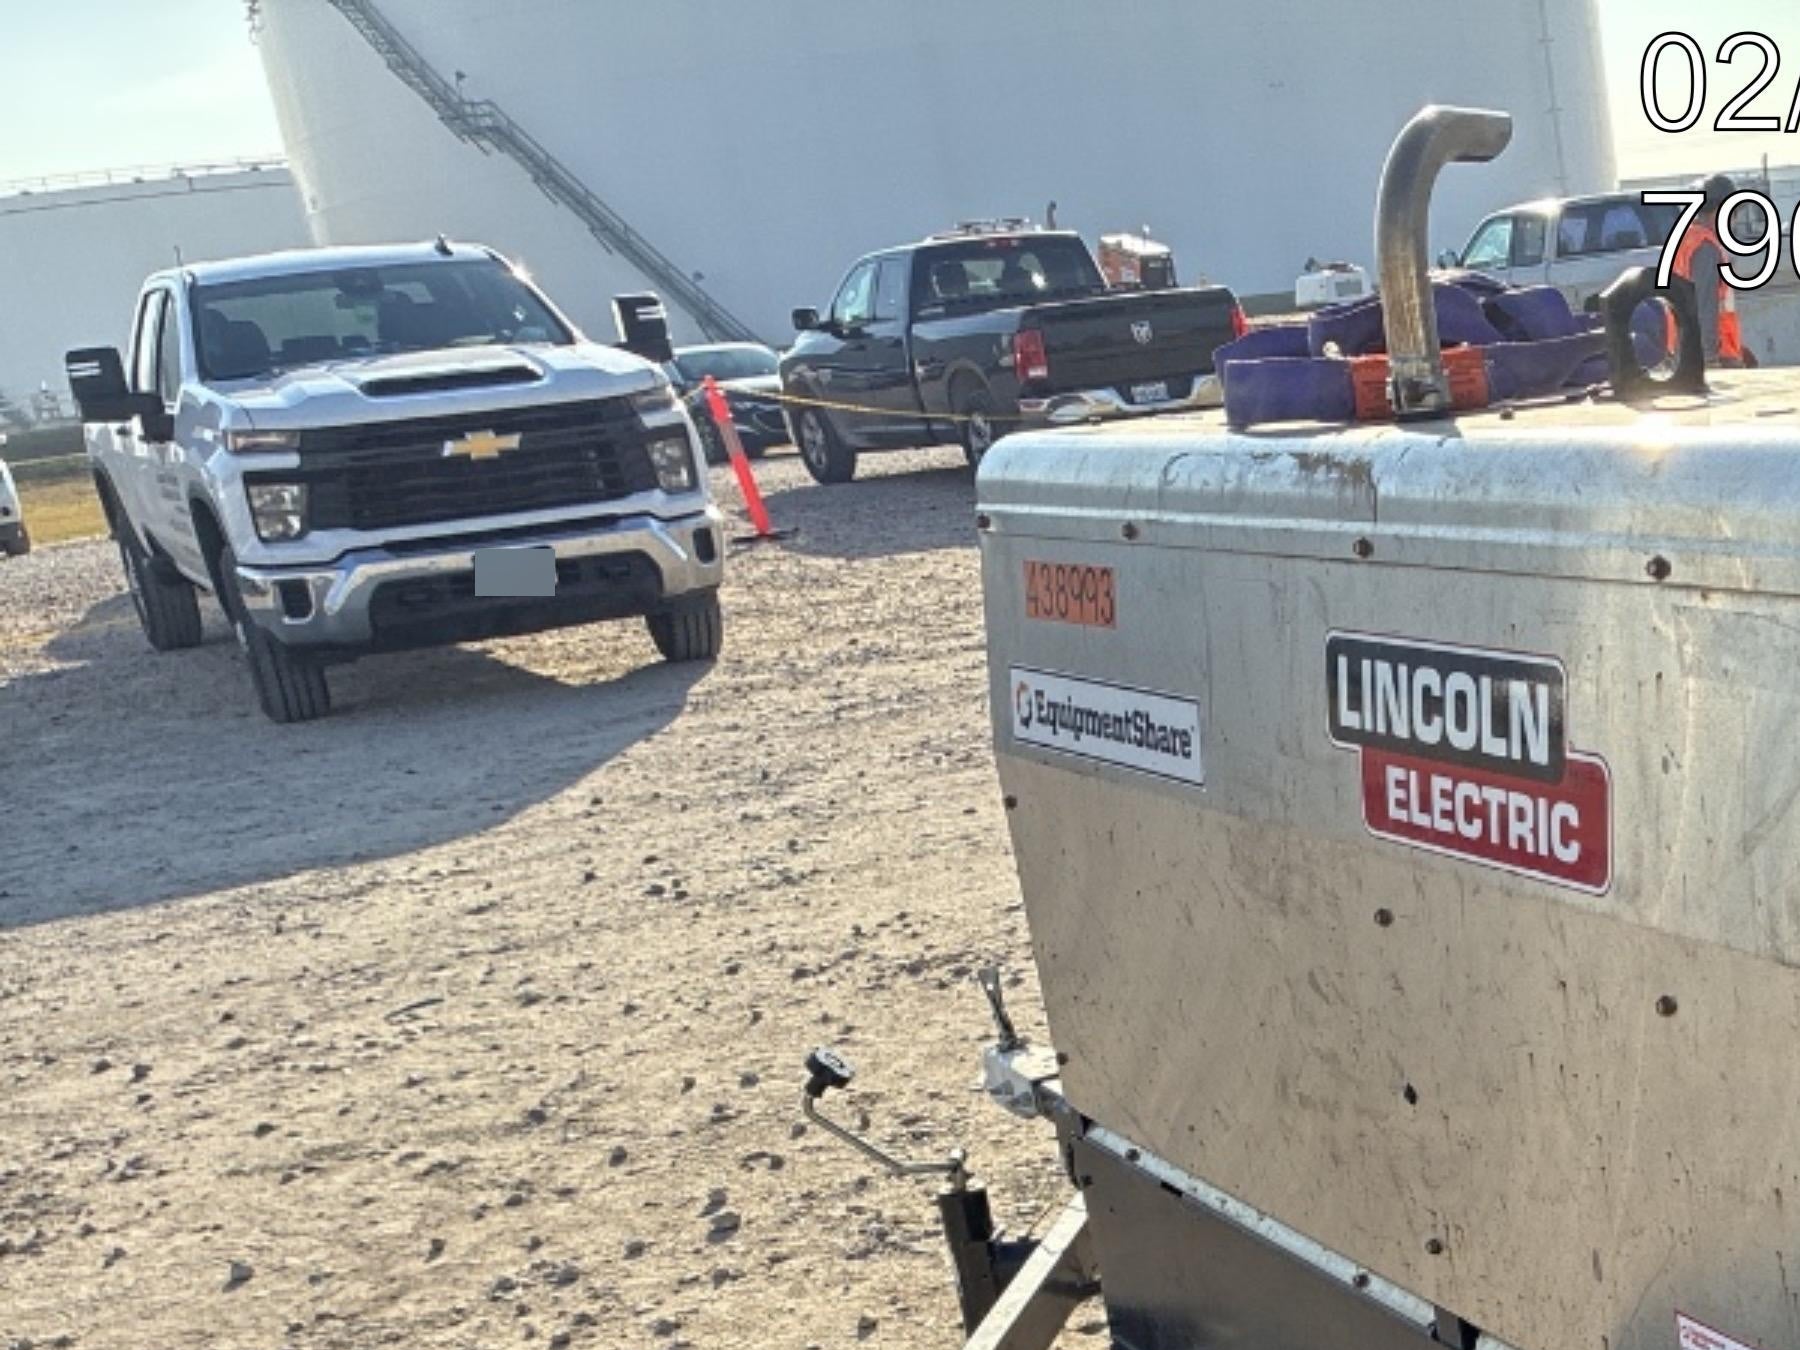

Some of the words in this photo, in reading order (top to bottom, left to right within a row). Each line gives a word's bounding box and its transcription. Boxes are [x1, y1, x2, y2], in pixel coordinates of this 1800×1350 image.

[1026, 562, 1114, 625] 438993
[1034, 689, 1193, 760] EquipmentShare
[1336, 655, 1550, 765] LINCOLN
[1385, 766, 1583, 865] ELECTRIC
